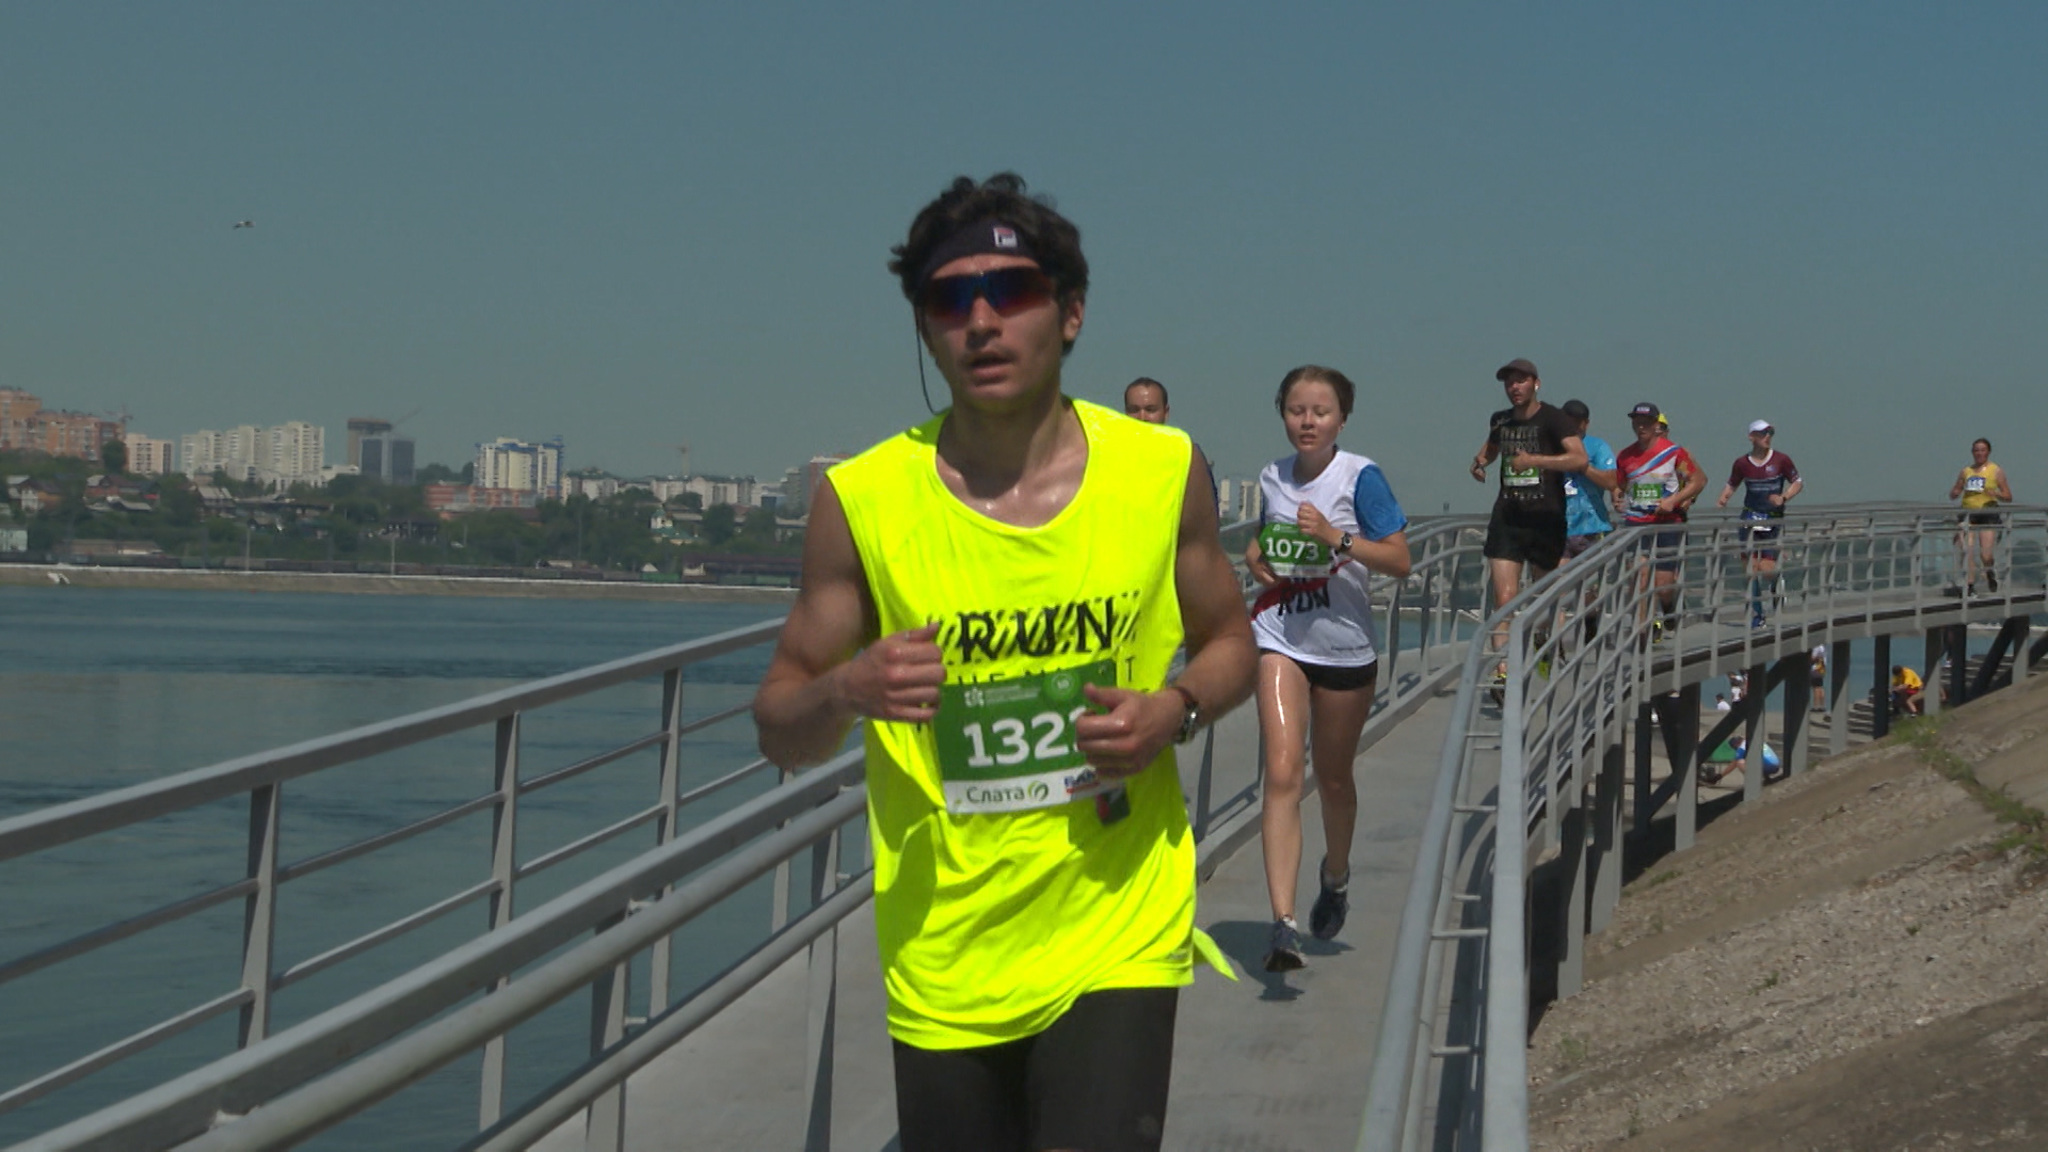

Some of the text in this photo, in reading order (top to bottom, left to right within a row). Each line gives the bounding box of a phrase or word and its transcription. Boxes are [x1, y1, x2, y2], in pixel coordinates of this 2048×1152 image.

[1265, 536, 1320, 561] 1073
[957, 595, 1114, 665] RUN
[966, 786, 1026, 804] Слата
